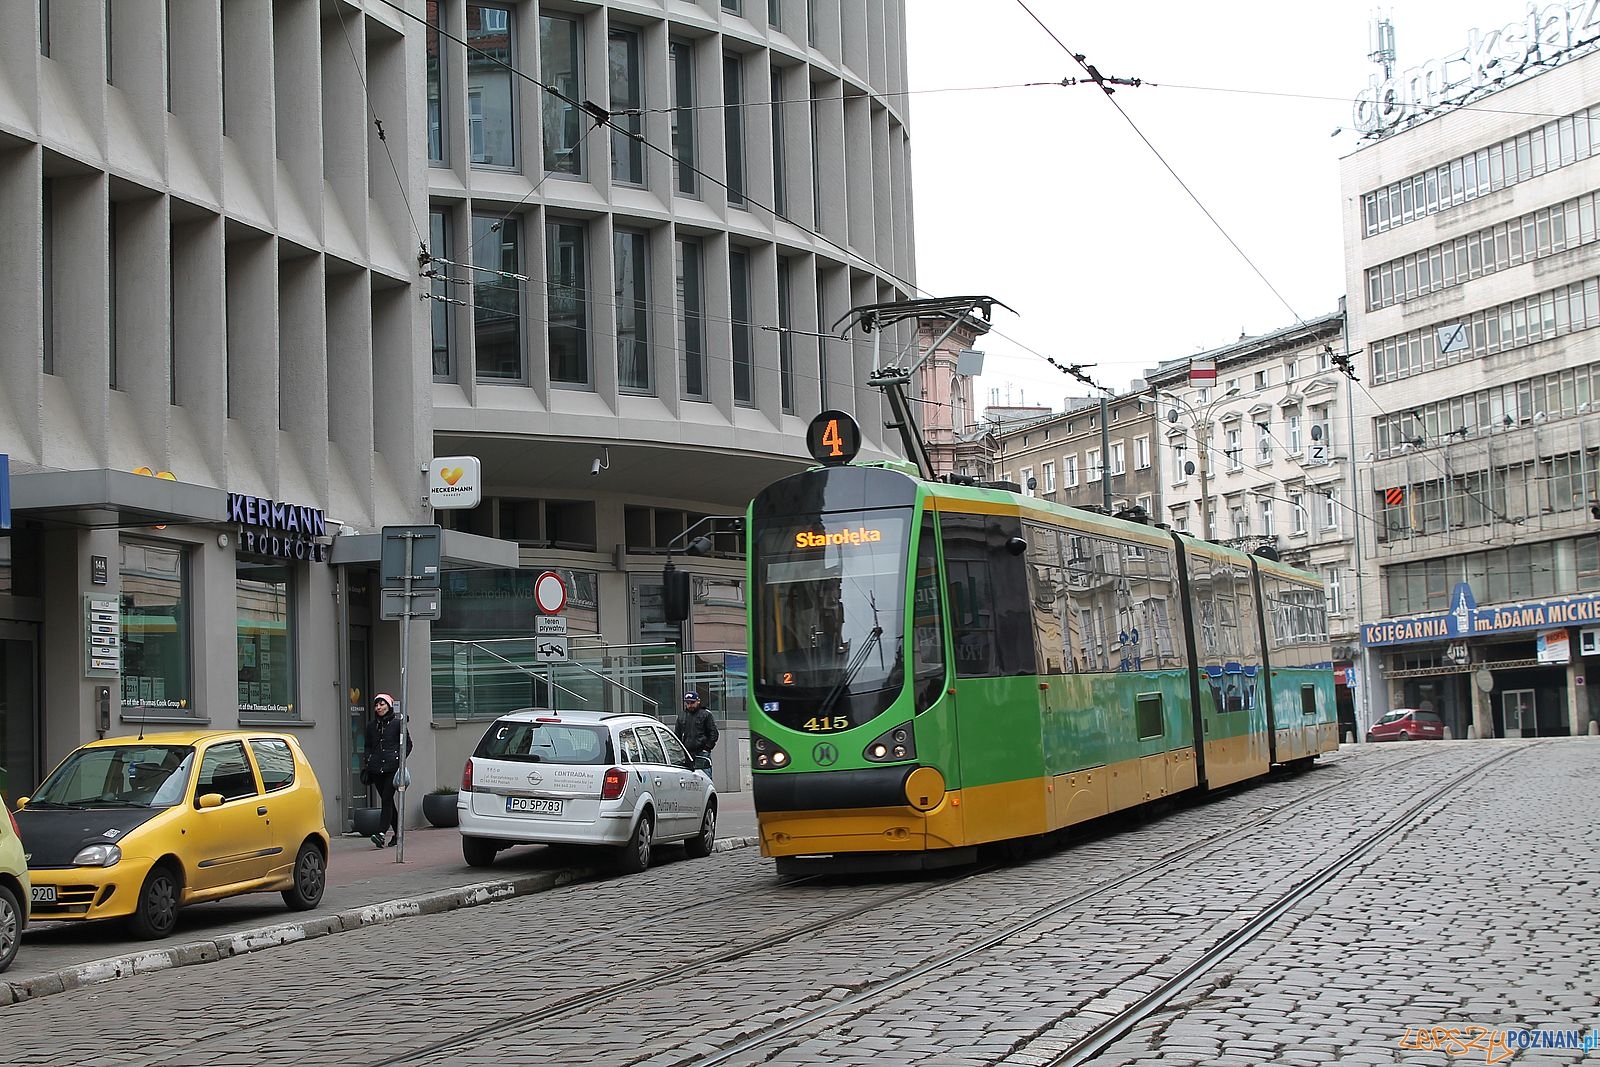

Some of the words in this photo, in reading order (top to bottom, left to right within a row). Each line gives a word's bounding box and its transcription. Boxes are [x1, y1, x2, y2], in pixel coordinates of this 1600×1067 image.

[823, 419, 843, 456] 4
[1312, 447, 1324, 458] Z
[796, 527, 881, 548] Starołęka
[539, 624, 565, 633] prywatny
[1366, 619, 1448, 643] KSIĘGARNIA
[1474, 616, 1493, 632] im.
[1494, 607, 1545, 629] ADAMA
[783, 673, 792, 684] 2
[140, 699, 156, 707] Thomas
[167, 700, 180, 709] Group
[277, 704, 288, 712] Group
[803, 715, 849, 731] 415
[512, 799, 527, 810] PO
[530, 800, 560, 811] 5P783
[32, 888, 54, 900] 920
